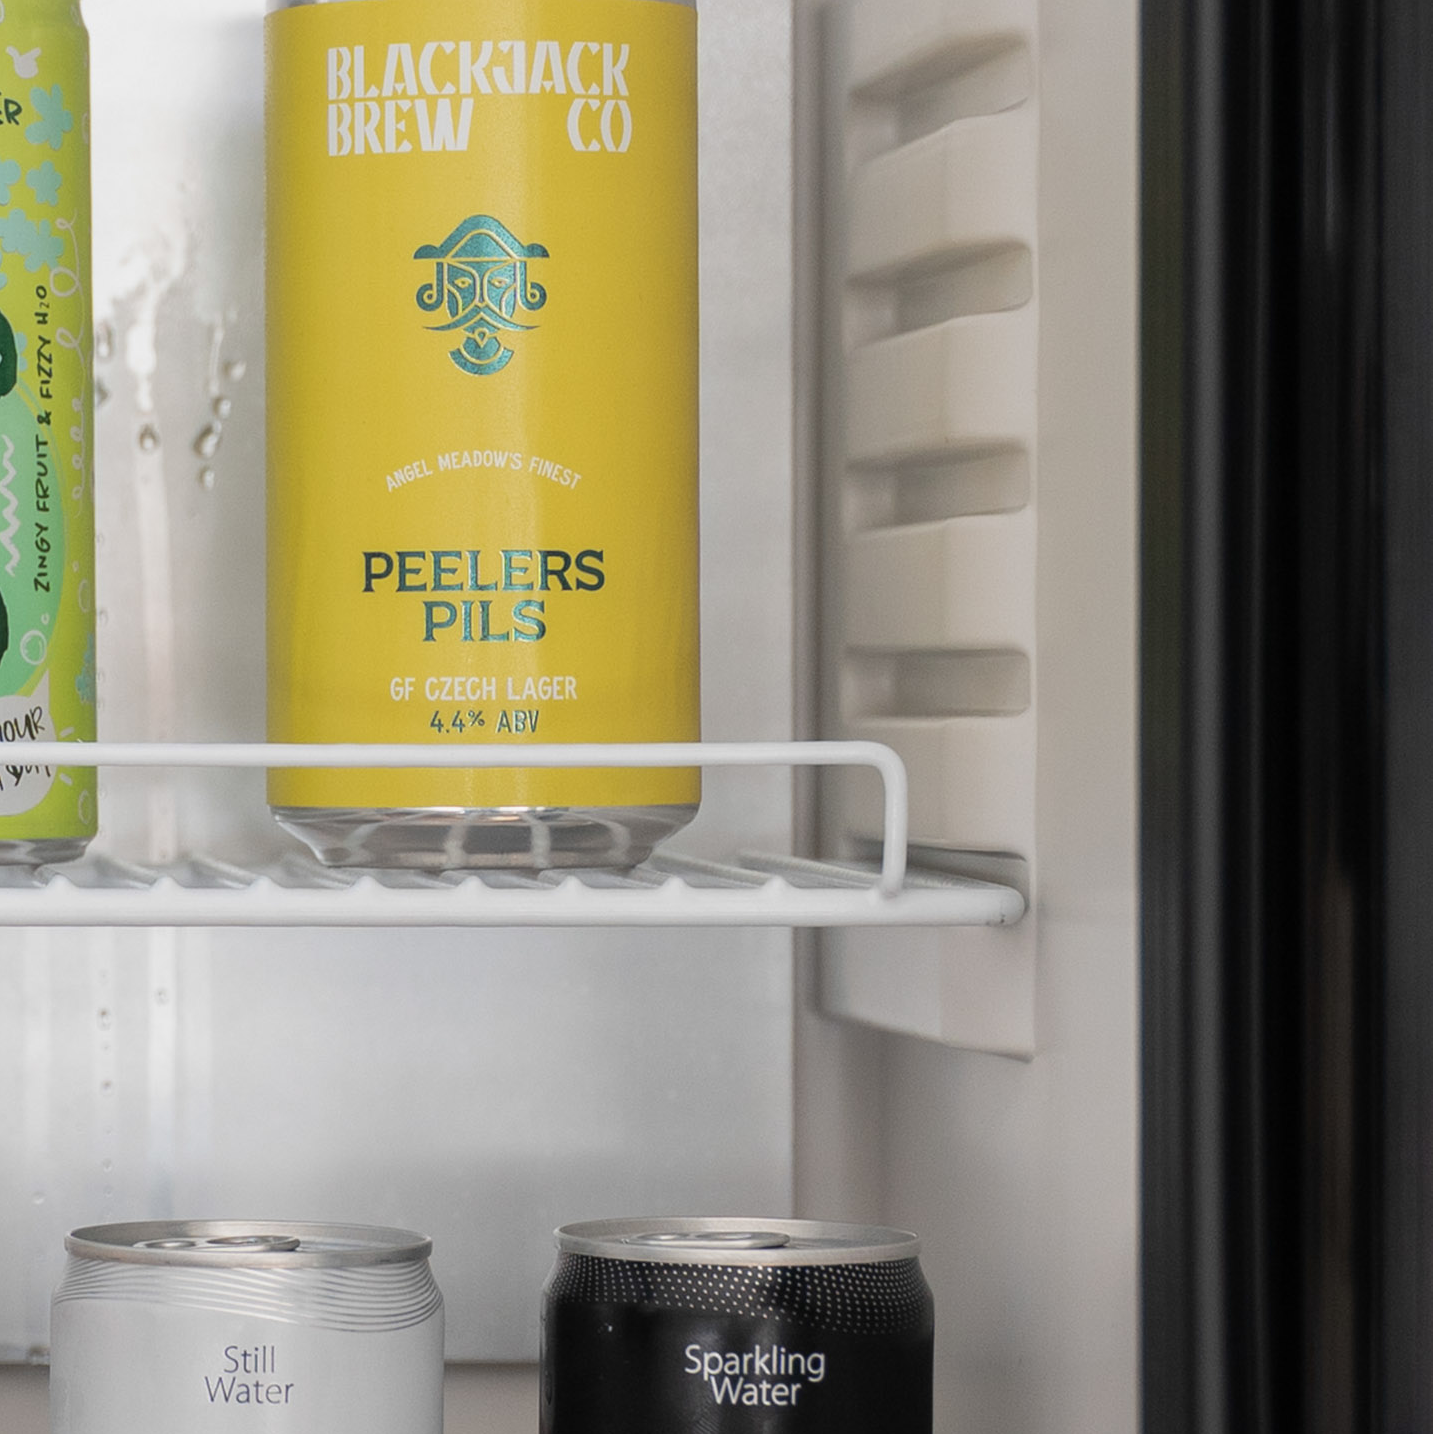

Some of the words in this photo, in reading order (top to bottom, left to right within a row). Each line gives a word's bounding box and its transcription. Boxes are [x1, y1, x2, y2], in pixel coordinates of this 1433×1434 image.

[327, 40, 630, 100] BLACKJACK
[327, 98, 474, 156] BREW
[567, 98, 632, 152] CO
[37, 335, 53, 400] FIZZY
[36, 410, 51, 426] &
[35, 434, 50, 512] FRUIT
[385, 459, 433, 492] ANGEL
[437, 450, 523, 471] MEADOW'S
[528, 456, 582, 489] FINEST
[33, 522, 52, 593] ZINGY
[361, 549, 605, 593] PEELERS
[422, 599, 546, 642] PILS
[390, 677, 415, 701] GF
[425, 677, 497, 701] CZECH
[507, 676, 577, 700] LAGER
[430, 710, 485, 734] 4.4%
[496, 710, 539, 734] ABV
[223, 1345, 275, 1373] Still
[684, 1343, 825, 1382] Sparkling
[204, 1376, 294, 1404] Water
[710, 1375, 802, 1406] Water
